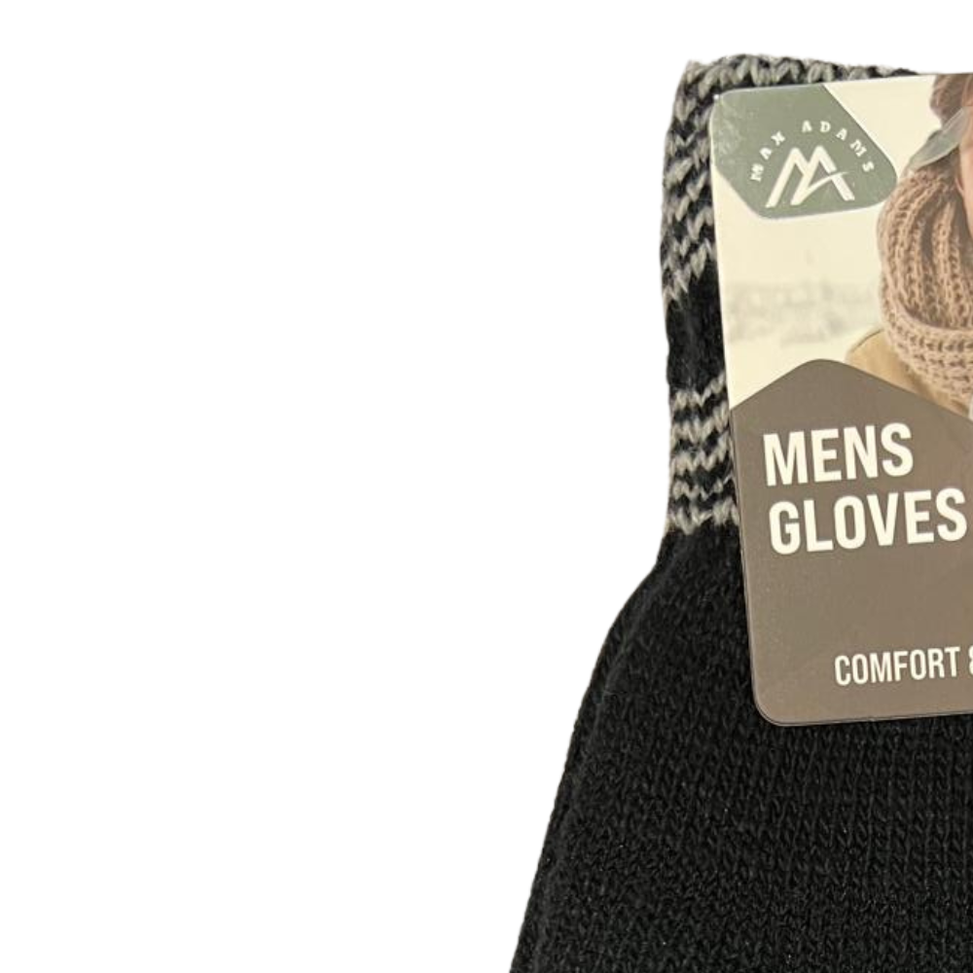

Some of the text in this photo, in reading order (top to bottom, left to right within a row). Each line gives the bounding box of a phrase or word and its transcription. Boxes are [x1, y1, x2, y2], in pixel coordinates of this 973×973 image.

[751, 120, 875, 182] MAX ADAMS
[763, 422, 914, 487] MENS
[768, 487, 968, 555] GLOVES
[834, 646, 961, 687] COMFORT
